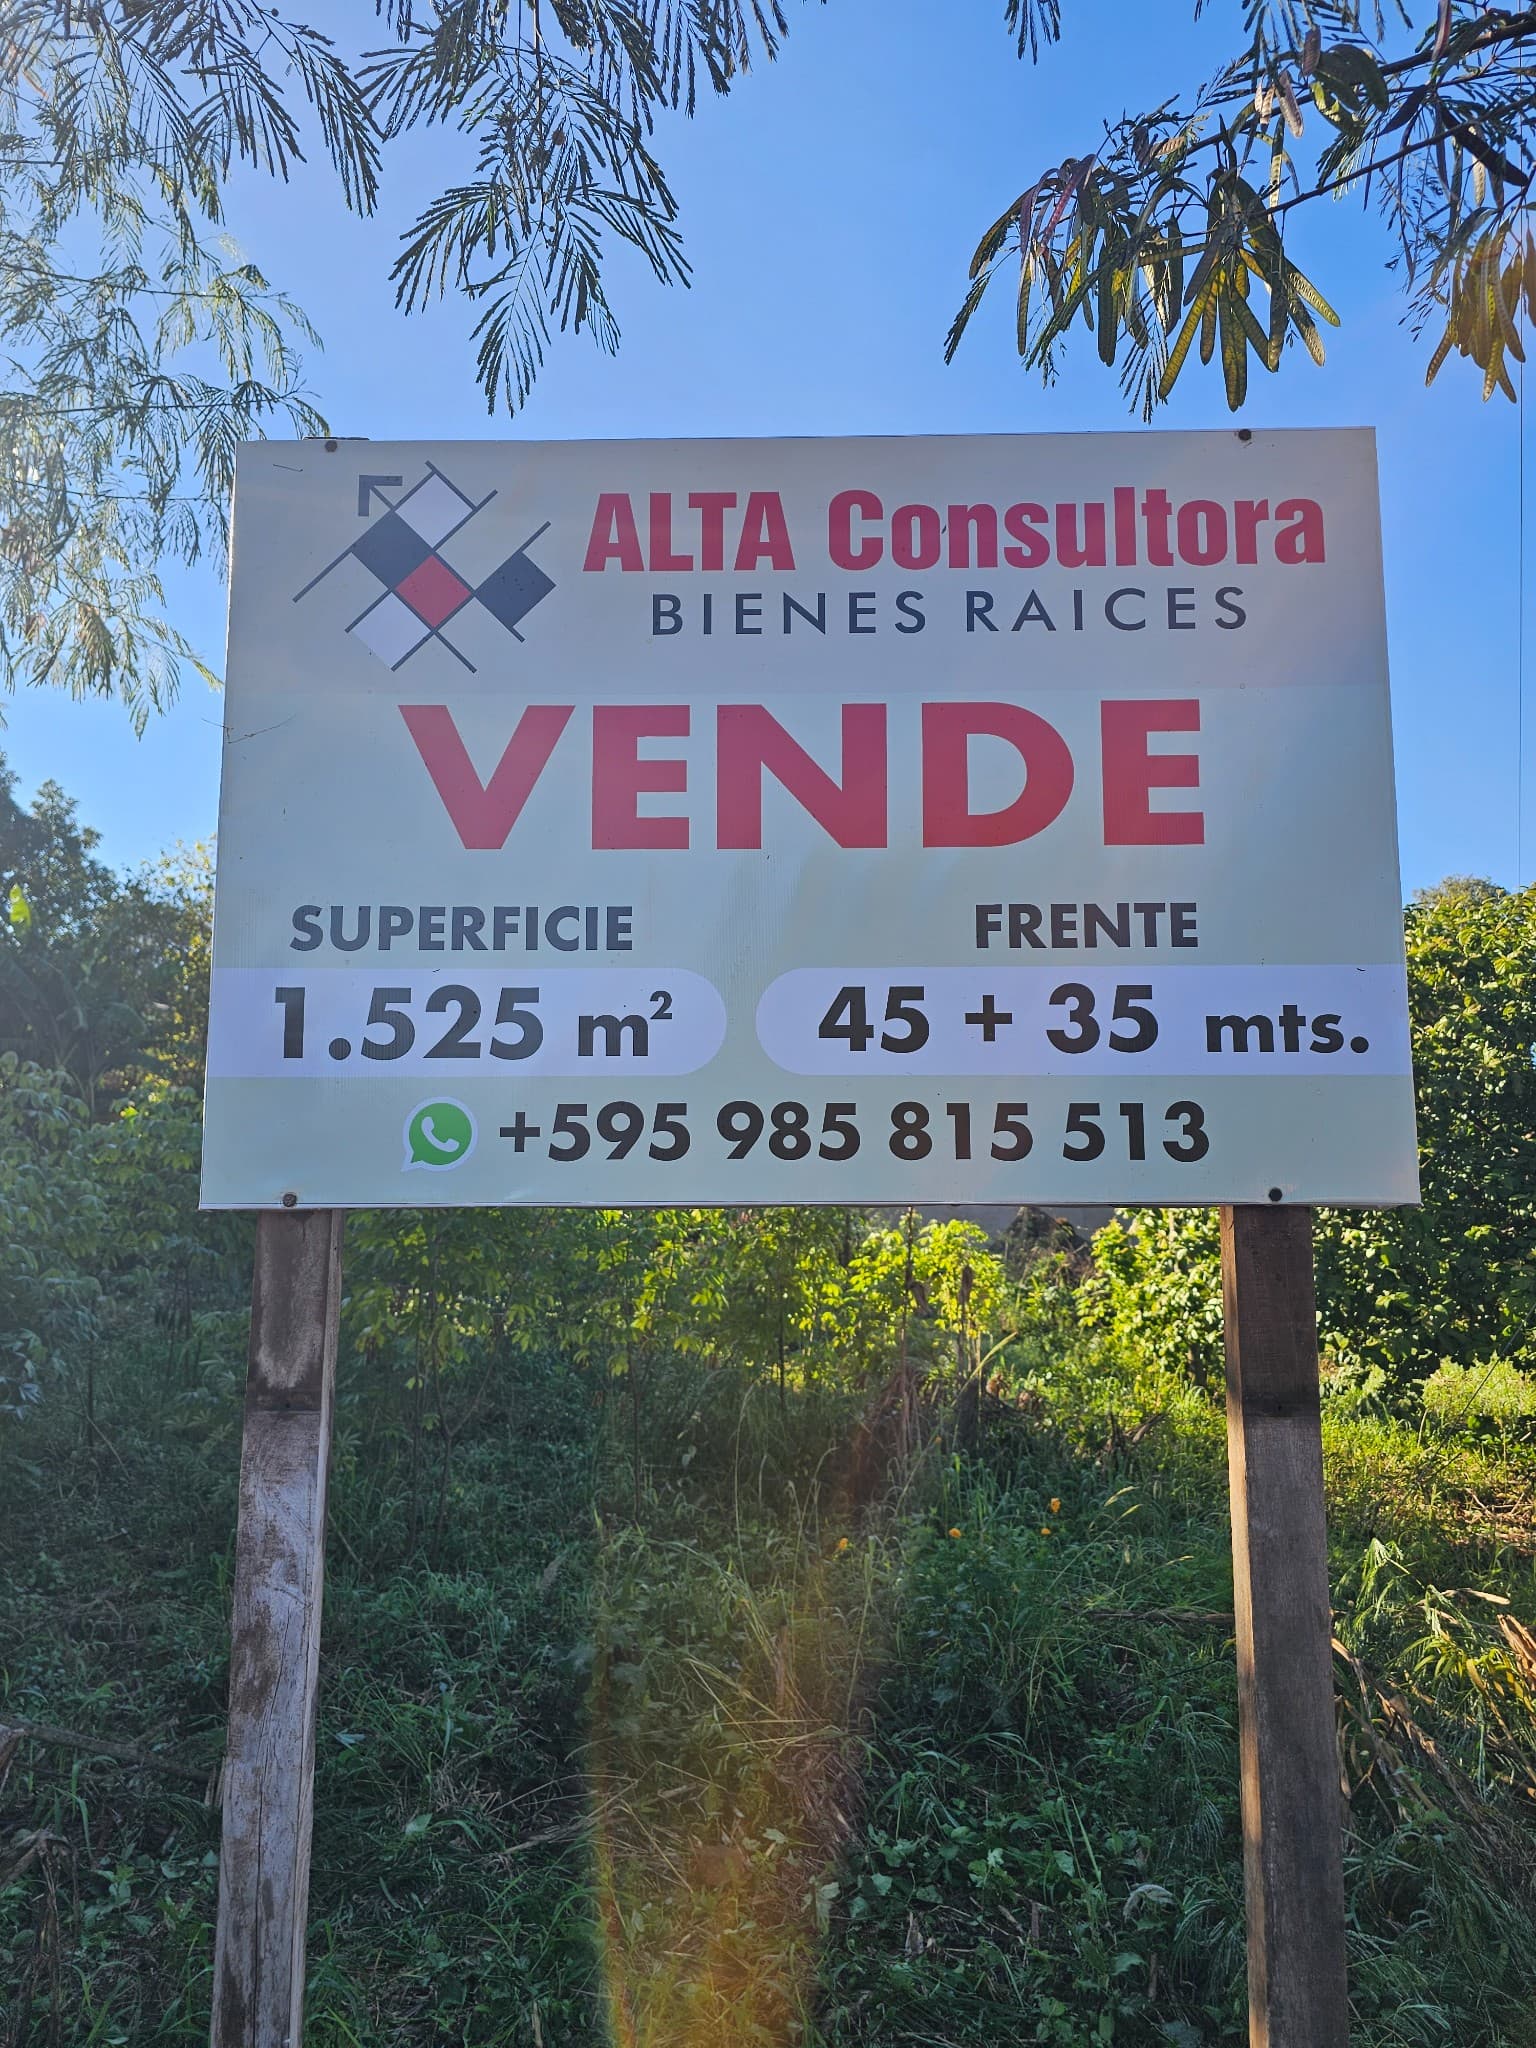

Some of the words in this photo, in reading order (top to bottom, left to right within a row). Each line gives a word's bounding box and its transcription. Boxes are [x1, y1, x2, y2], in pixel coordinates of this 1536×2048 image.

[583, 492, 796, 572] ALTA
[829, 487, 1326, 571] Consultora
[653, 591, 926, 636] BIENES
[967, 587, 1247, 633] RAICES
[399, 699, 1205, 850] VENDE
[290, 905, 633, 952] SUPERFICIE
[976, 903, 1199, 949] FRENTE
[275, 985, 544, 1061] 1.525
[819, 986, 930, 1054] 45
[965, 995, 1013, 1042] +
[1046, 983, 1159, 1055] 35
[1206, 1005, 1370, 1054] mts.
[500, 1101, 691, 1162] +595
[717, 1101, 861, 1162] 985
[889, 1102, 1034, 1162] 815
[1063, 1101, 1210, 1163] 513
